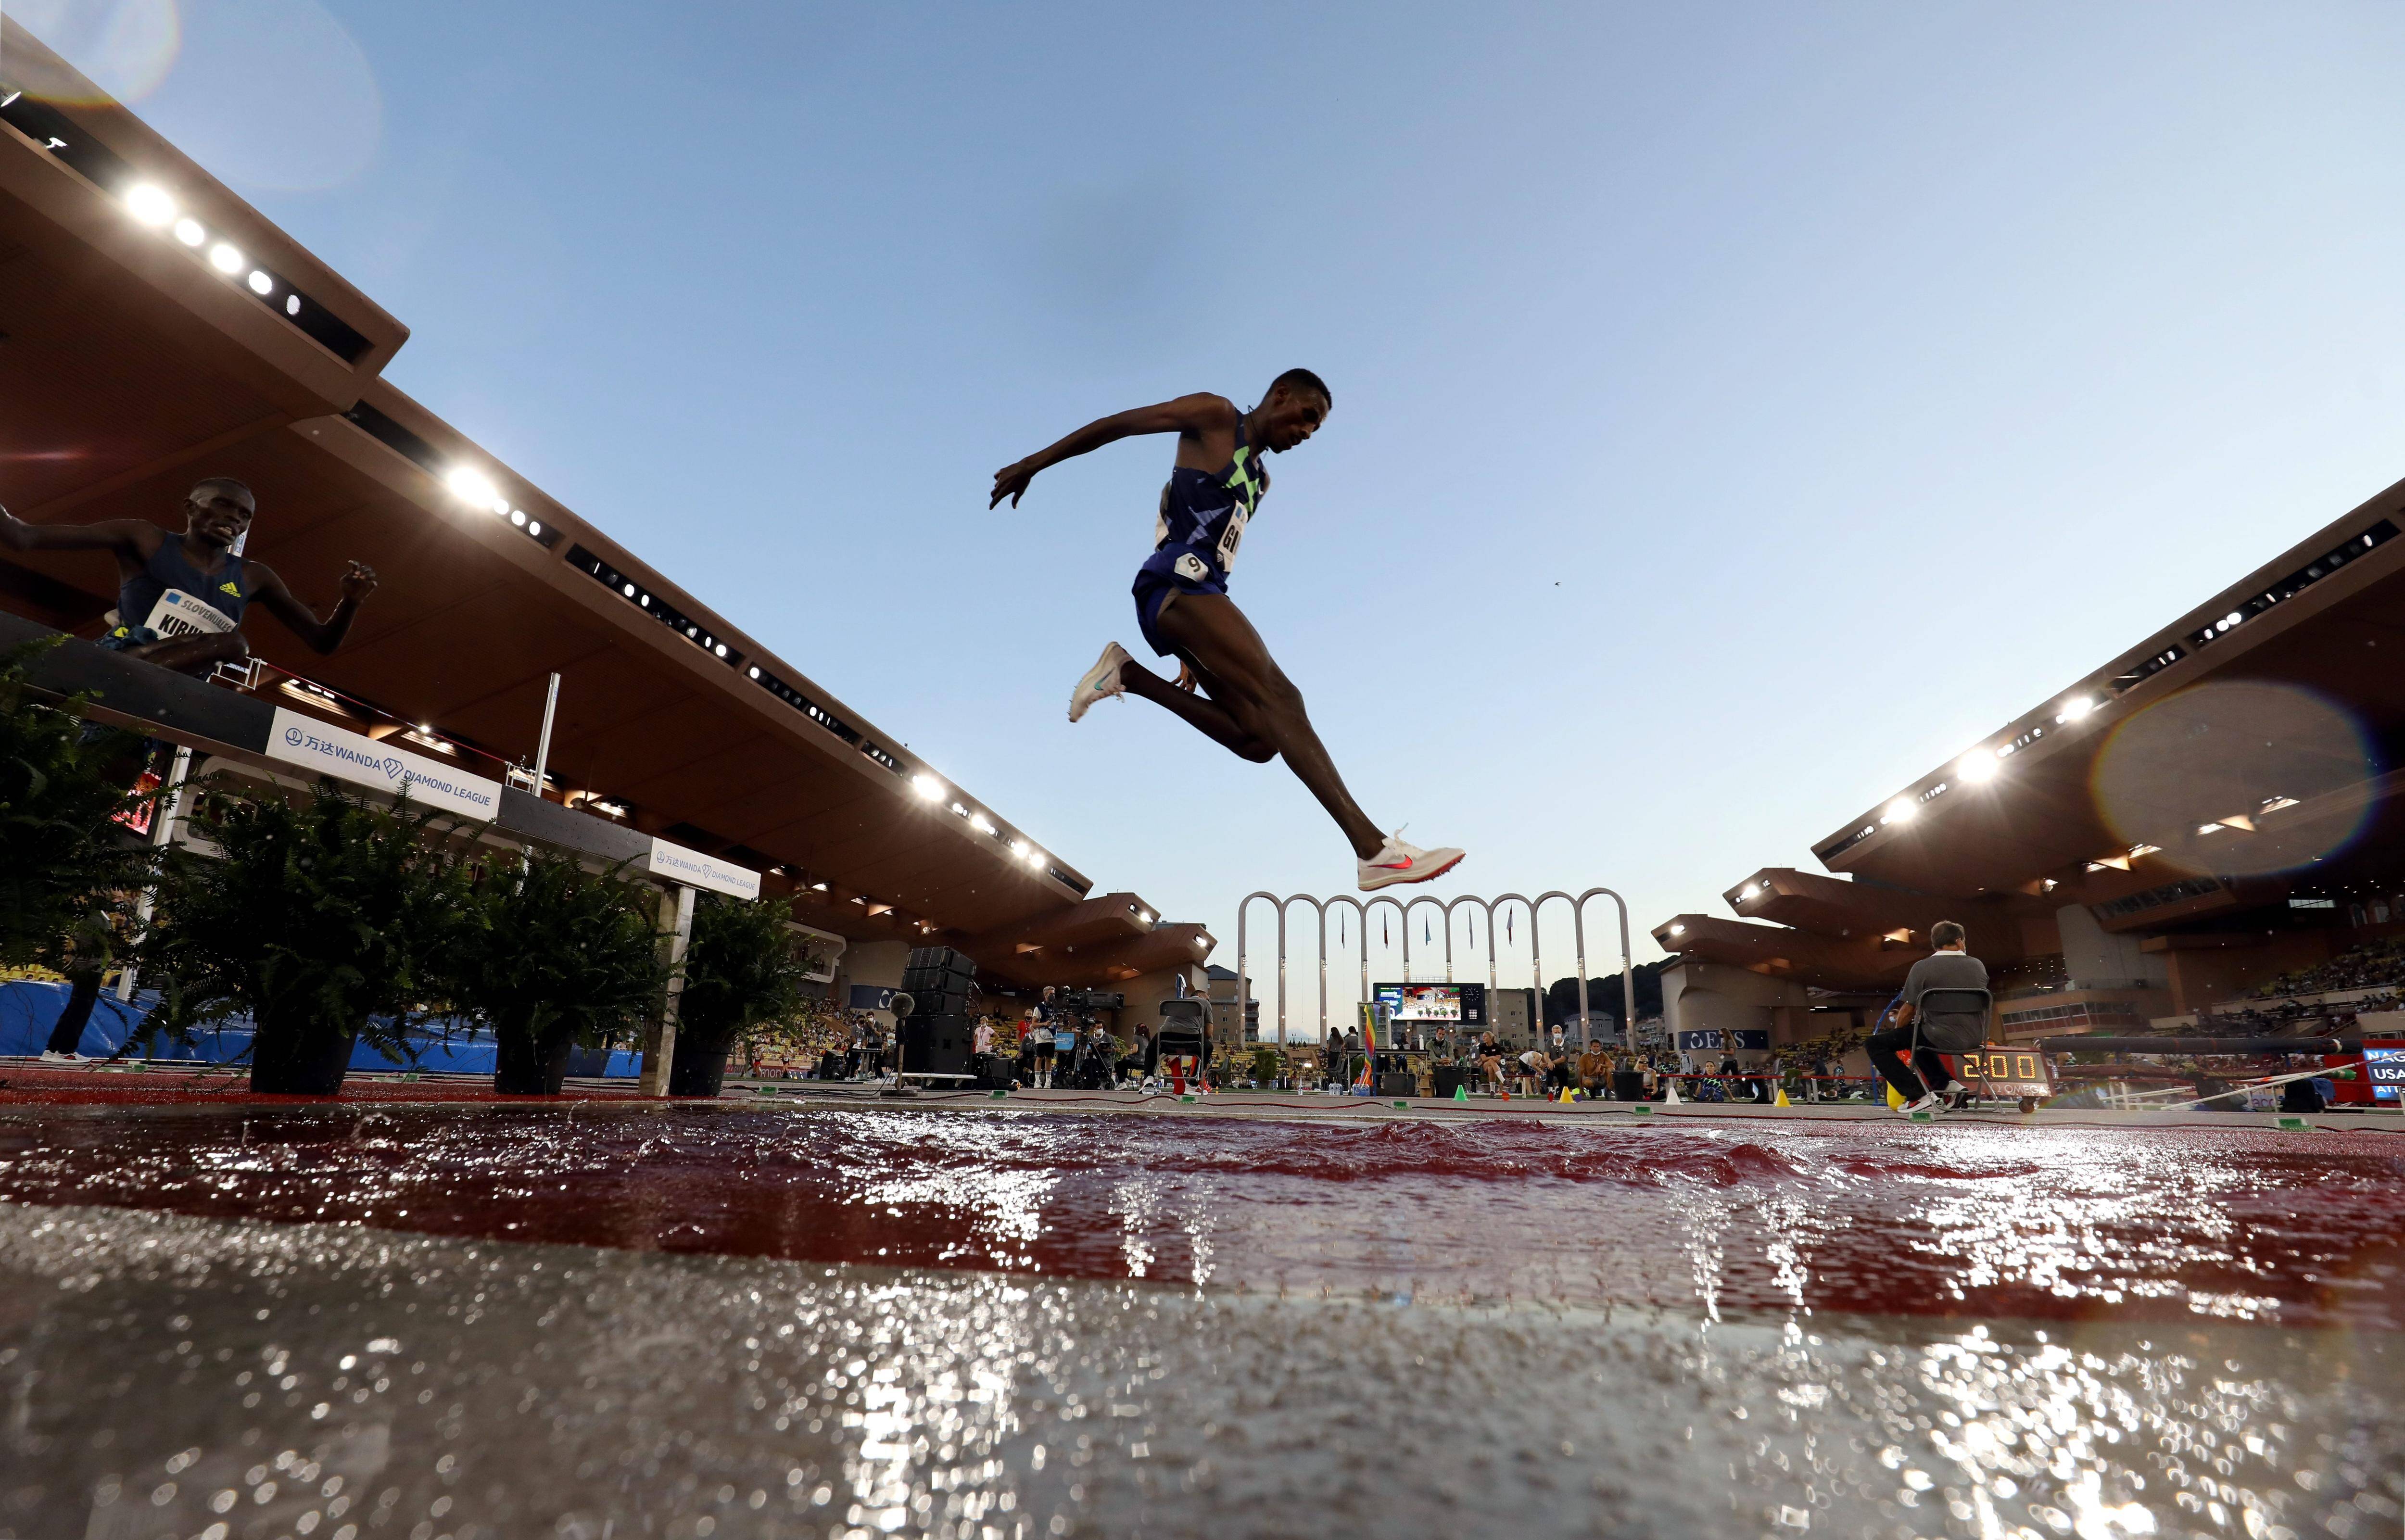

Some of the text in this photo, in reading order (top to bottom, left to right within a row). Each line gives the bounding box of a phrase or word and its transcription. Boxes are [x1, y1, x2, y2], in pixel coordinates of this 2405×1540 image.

[1188, 557, 1201, 572] 9
[219, 586, 241, 597] adidas
[335, 747, 381, 771] WANDA
[404, 770, 452, 794] DIAMOND
[453, 786, 491, 807] LEAGUE
[679, 859, 702, 874] WANDA
[712, 871, 736, 884] DIAMOND
[736, 878, 755, 890] LEAGUE
[1705, 1031, 1745, 1048] ES
[2373, 1068, 2405, 1079] USA
[2004, 1084, 2048, 1094] OMEGA
